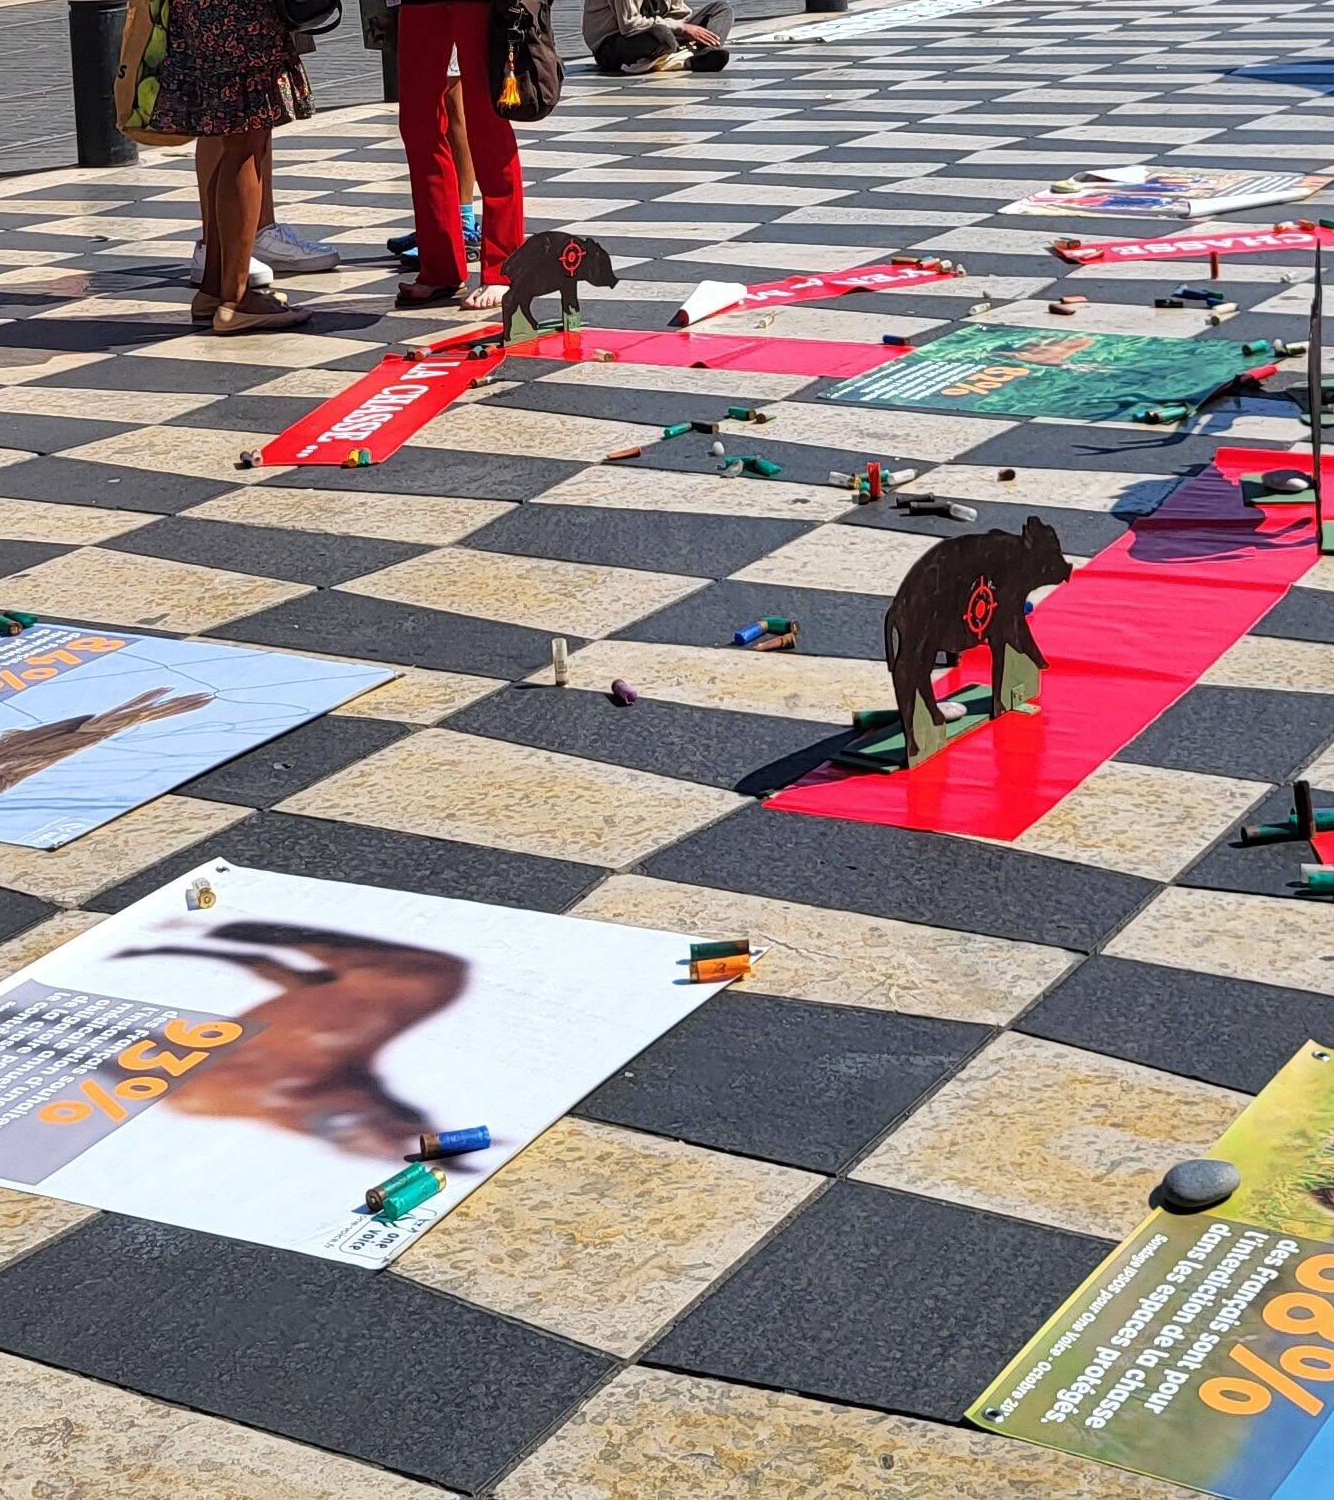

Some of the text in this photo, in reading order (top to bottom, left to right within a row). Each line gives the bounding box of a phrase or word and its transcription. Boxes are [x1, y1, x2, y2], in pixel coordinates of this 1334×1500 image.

[1114, 233, 1314, 256] CHASSE
[400, 360, 461, 382] LA
[317, 384, 430, 444] CHASSE
[46, 992, 71, 1001] le
[62, 996, 95, 1009] de
[16, 997, 115, 1053] obligatoire
[42, 1009, 71, 1020] la
[53, 1001, 137, 1049] médicale
[144, 1011, 178, 1029] des
[37, 1005, 160, 1077] l'instauration
[66, 1029, 149, 1076] Français
[38, 1019, 242, 1126] 93%
[348, 1229, 382, 1251] voice
[375, 1232, 400, 1249] one
[1127, 1234, 1168, 1267] Sondage
[1108, 1266, 1138, 1293] IPSOS
[1089, 1289, 1113, 1314] pour
[1041, 1224, 1231, 1422] dans les espaces protégés.
[1072, 1313, 1096, 1331] One
[1085, 1231, 1269, 1428] l'interdiction de la chasse
[1144, 1240, 1299, 1414] des Français sont pour
[1050, 1332, 1081, 1356] Voice
[1012, 1362, 1051, 1399] Octobre
